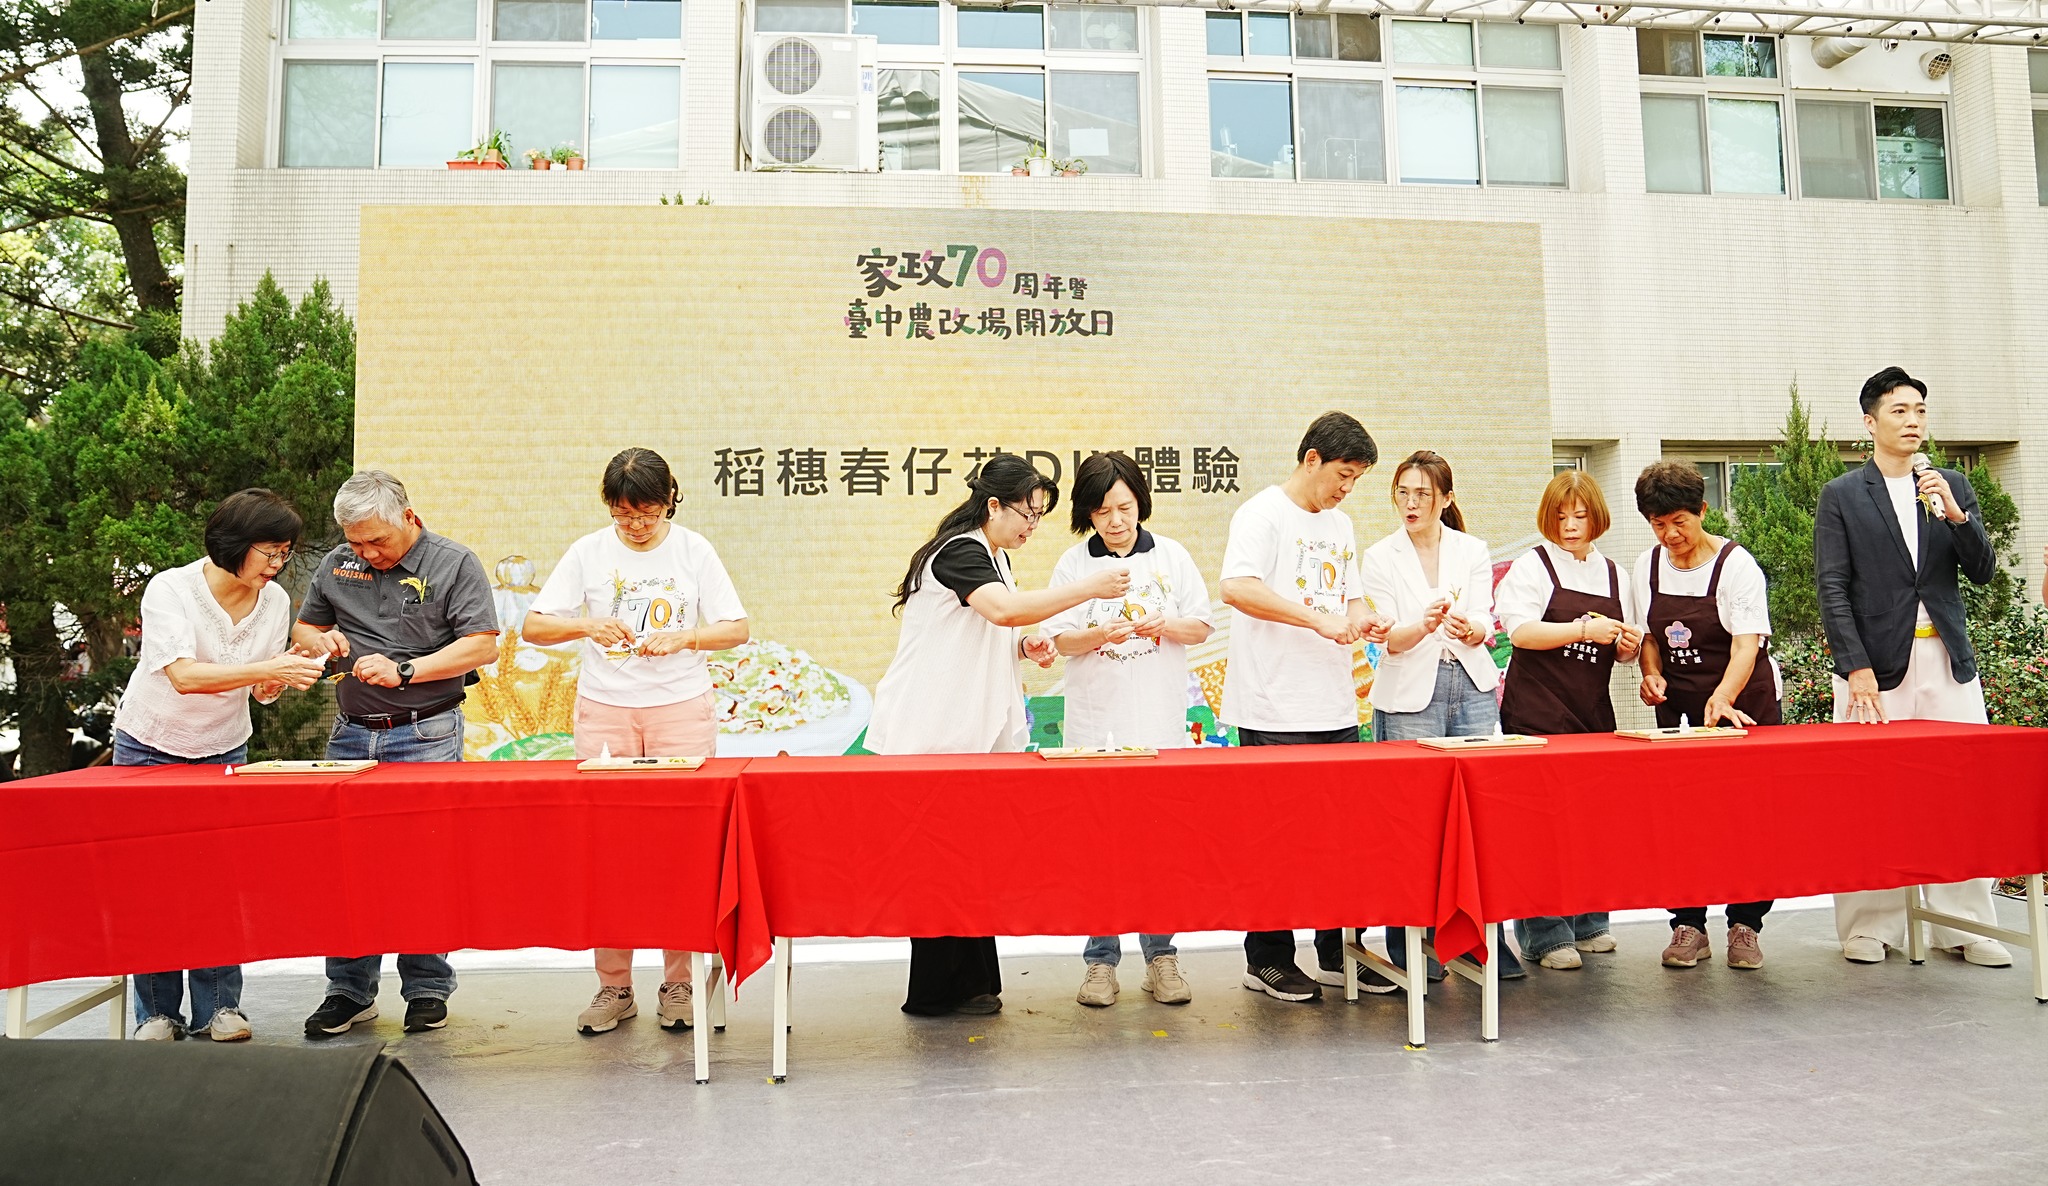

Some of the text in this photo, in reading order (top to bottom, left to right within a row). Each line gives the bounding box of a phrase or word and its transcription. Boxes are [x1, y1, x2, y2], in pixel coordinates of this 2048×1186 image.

[844, 298, 1113, 340] 臺中農改場開放日
[714, 446, 1240, 497] 稻穗春仔DI體驗
[340, 560, 361, 570] JACK
[1309, 557, 1336, 590] 70
[628, 598, 672, 632] 70
